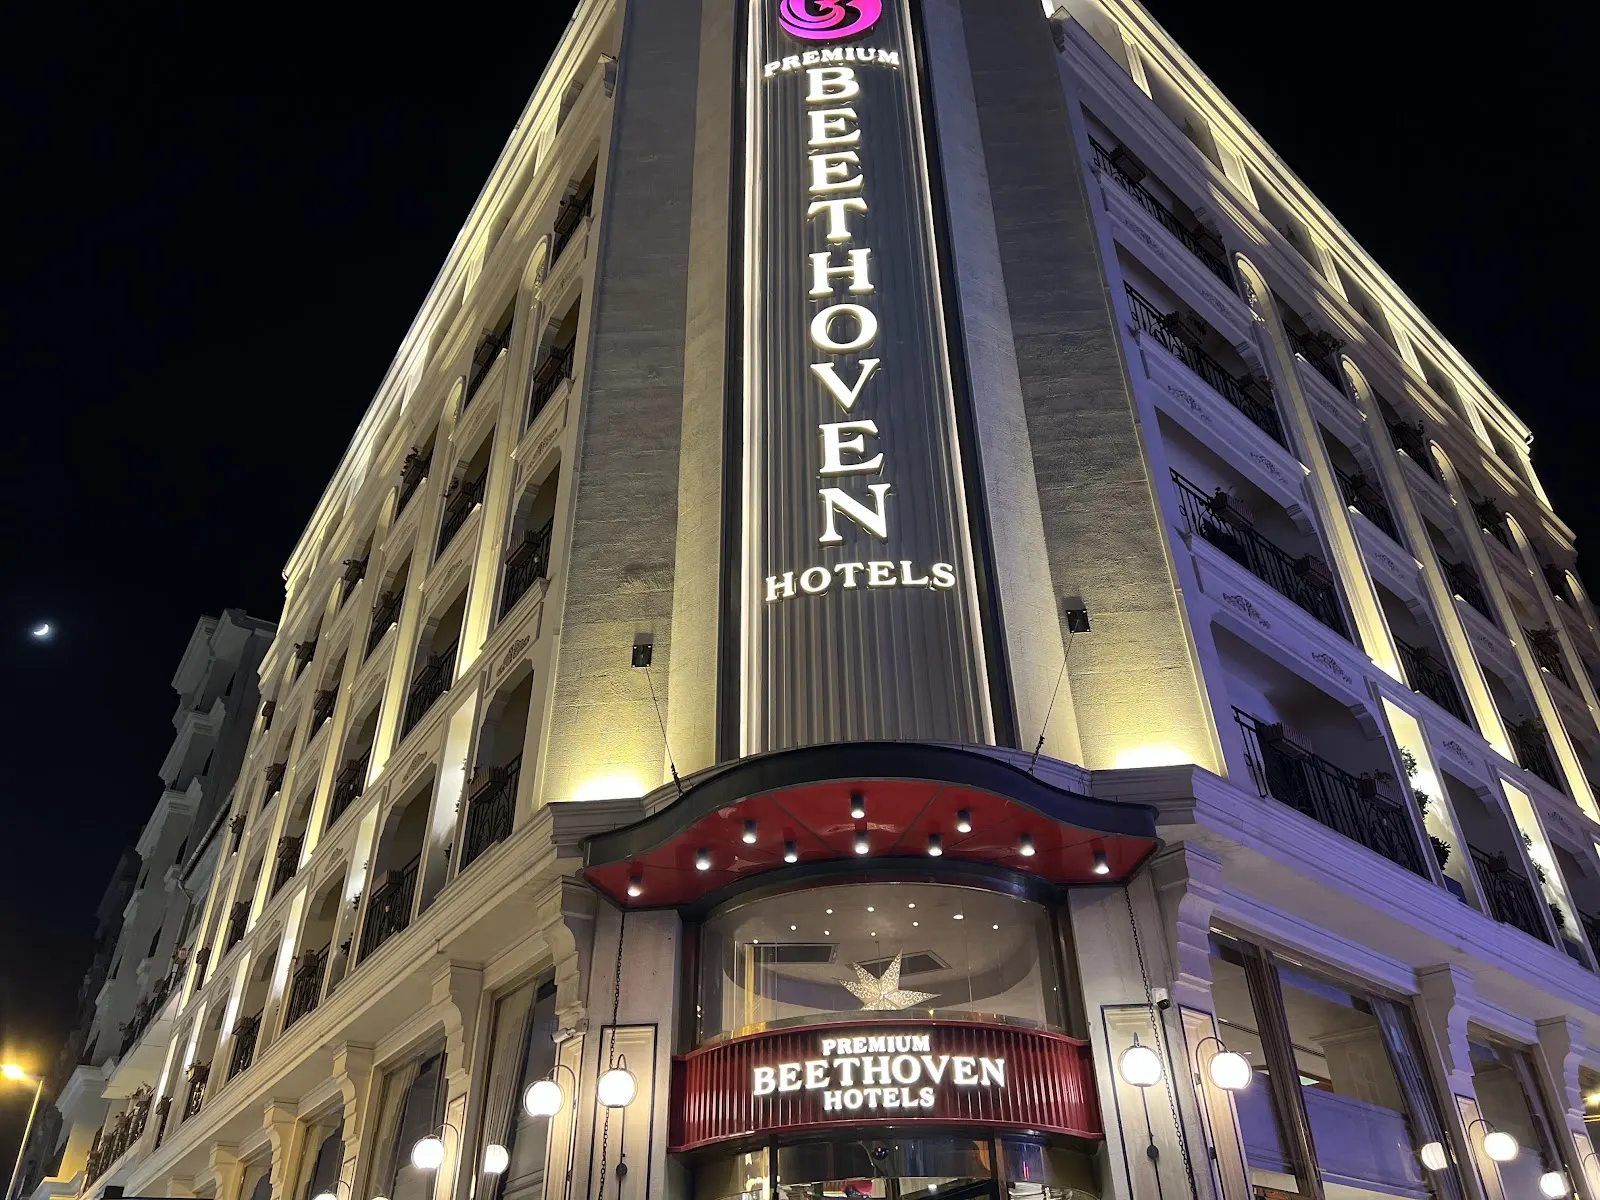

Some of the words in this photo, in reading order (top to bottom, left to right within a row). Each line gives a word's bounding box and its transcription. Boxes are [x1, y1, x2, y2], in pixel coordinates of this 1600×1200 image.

[764, 47, 900, 77] PREMIUM
[806, 66, 892, 544] BEETHOVEN
[765, 560, 956, 602] HOTELS
[822, 1035, 931, 1056] PREMIUM
[753, 1054, 1006, 1096] BEETHOVEN
[823, 1086, 936, 1111] HOTELS
